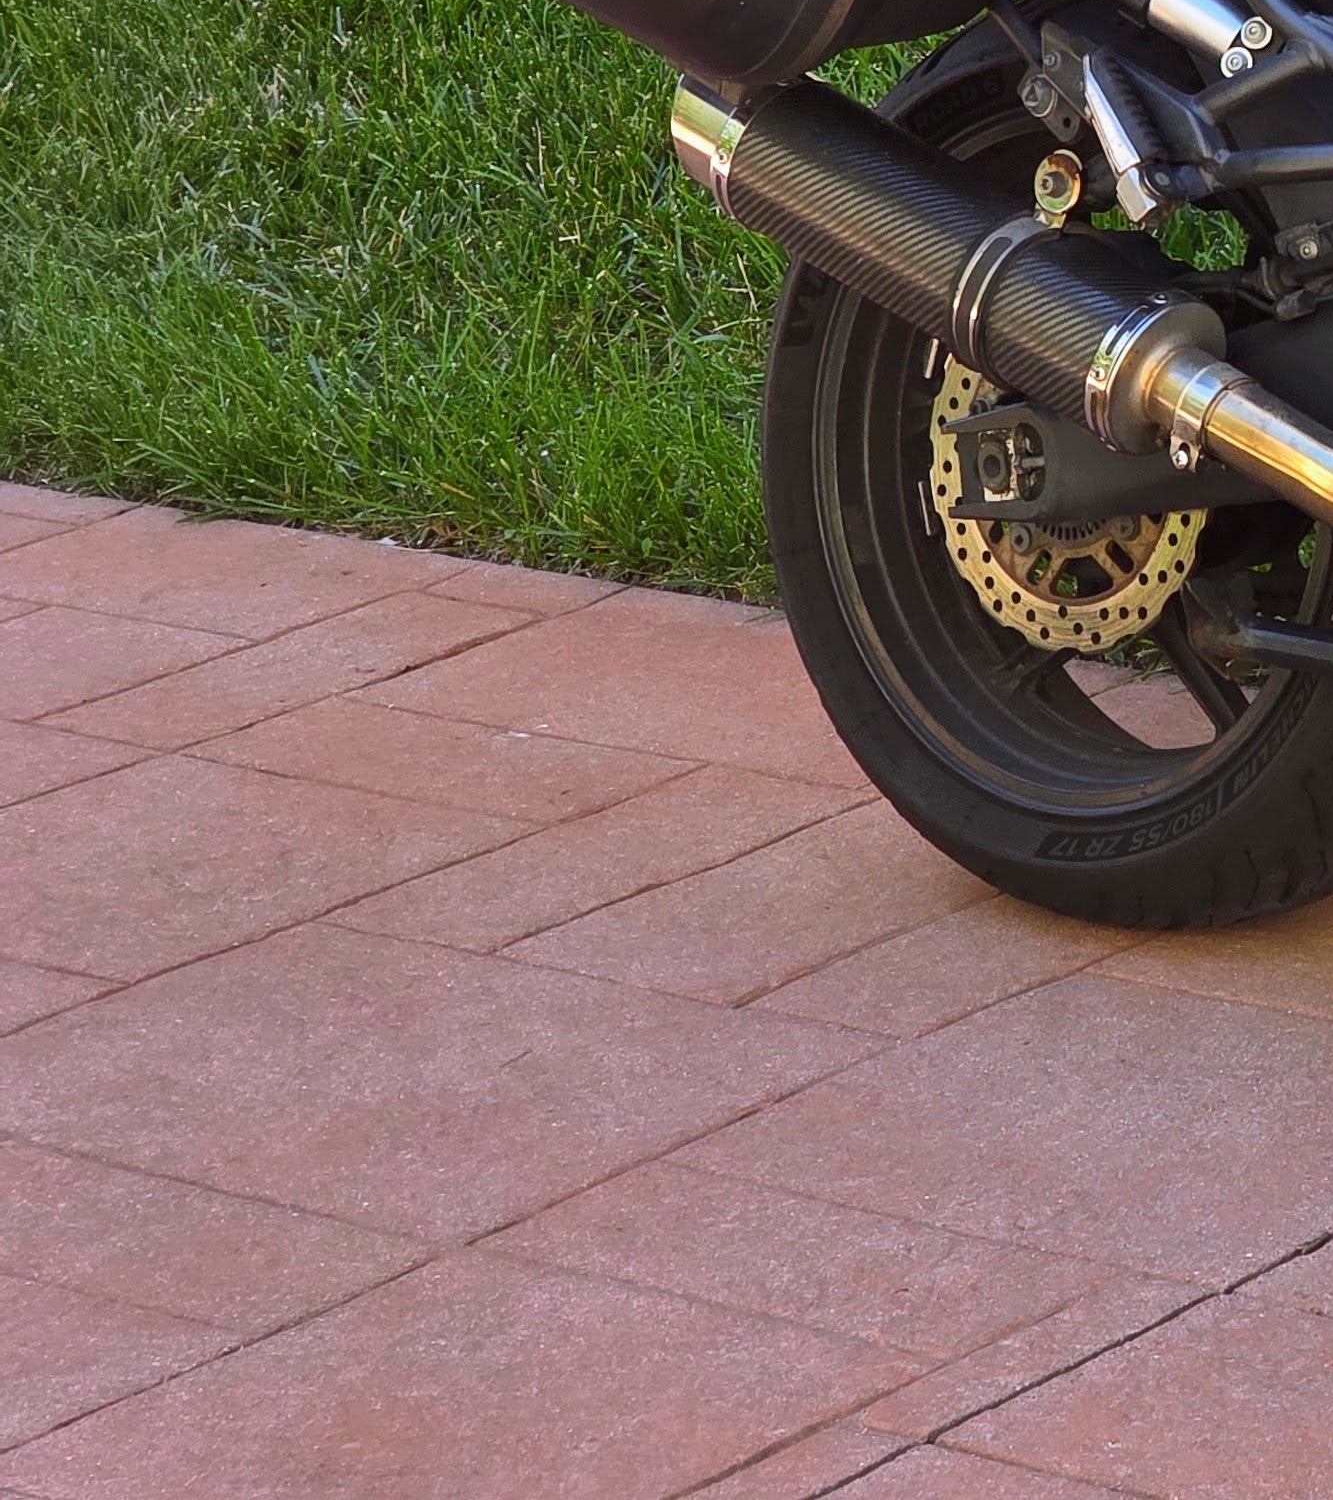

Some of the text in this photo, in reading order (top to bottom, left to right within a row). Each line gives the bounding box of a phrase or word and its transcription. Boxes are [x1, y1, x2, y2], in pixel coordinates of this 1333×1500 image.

[1048, 800, 1217, 857] 180/55 ZR 17
